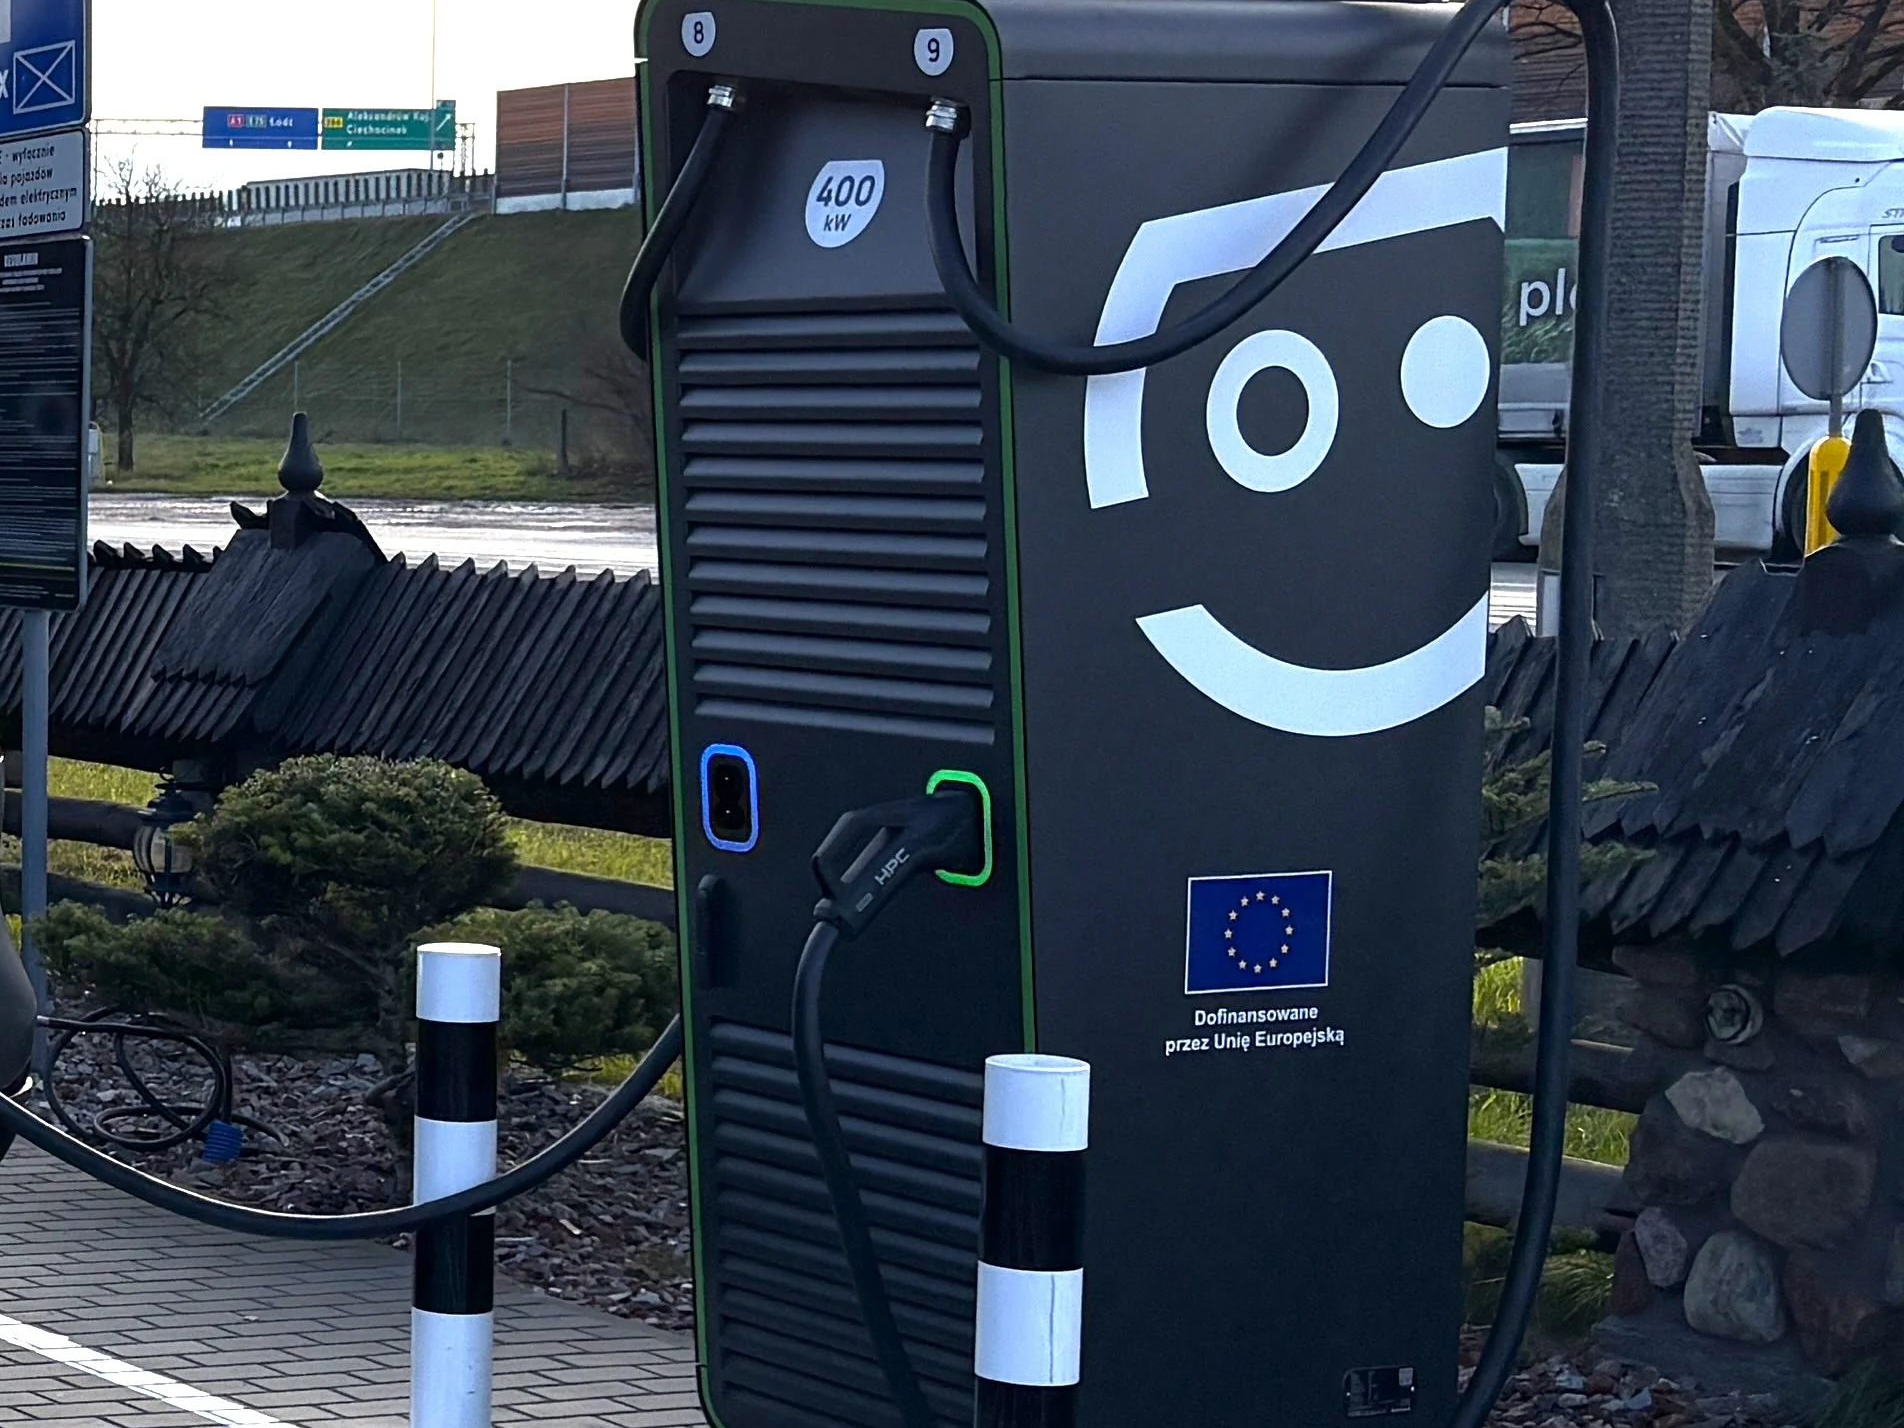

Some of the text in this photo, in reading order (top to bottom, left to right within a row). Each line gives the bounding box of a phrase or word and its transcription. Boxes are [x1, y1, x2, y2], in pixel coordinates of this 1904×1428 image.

[693, 20, 705, 45] 8
[927, 37, 940, 63] 9
[346, 123, 408, 135] Ciechocinek
[11, 144, 55, 165] wyłącznie
[10, 167, 54, 188] pojazdów
[20, 186, 77, 204] elektrycznym
[815, 174, 876, 207] 400
[18, 207, 66, 226] ładowania
[823, 213, 852, 232] kW
[1519, 267, 1578, 327] pl
[873, 847, 911, 885] HPC
[1194, 1006, 1319, 1026] Dofinansowane
[1165, 1026, 1345, 1057] przez Unię Europejską
